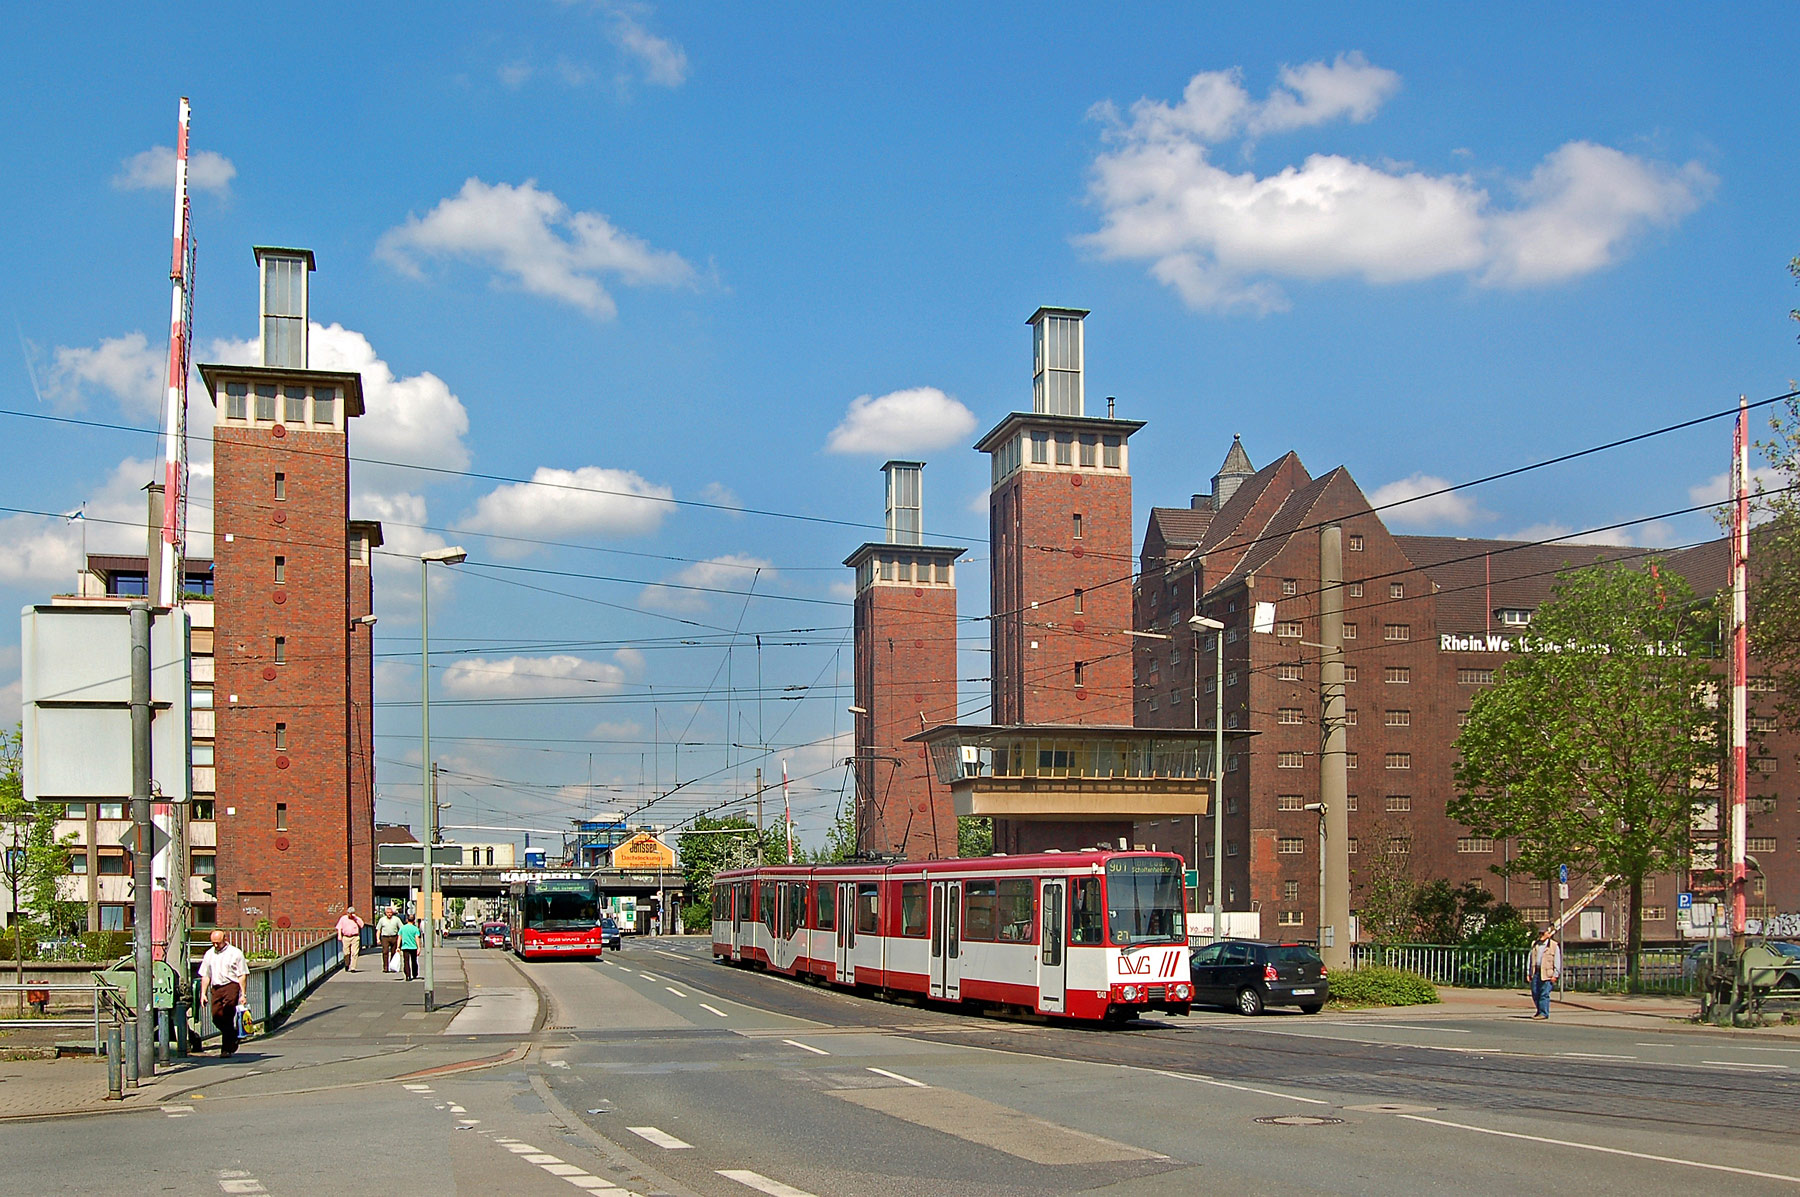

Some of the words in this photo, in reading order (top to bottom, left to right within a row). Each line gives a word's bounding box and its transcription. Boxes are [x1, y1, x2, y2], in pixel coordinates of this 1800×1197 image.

[1109, 864, 1127, 872] 901
[1679, 895, 1689, 906] P
[1116, 930, 1129, 941] 27
[1117, 955, 1151, 975] DVG
